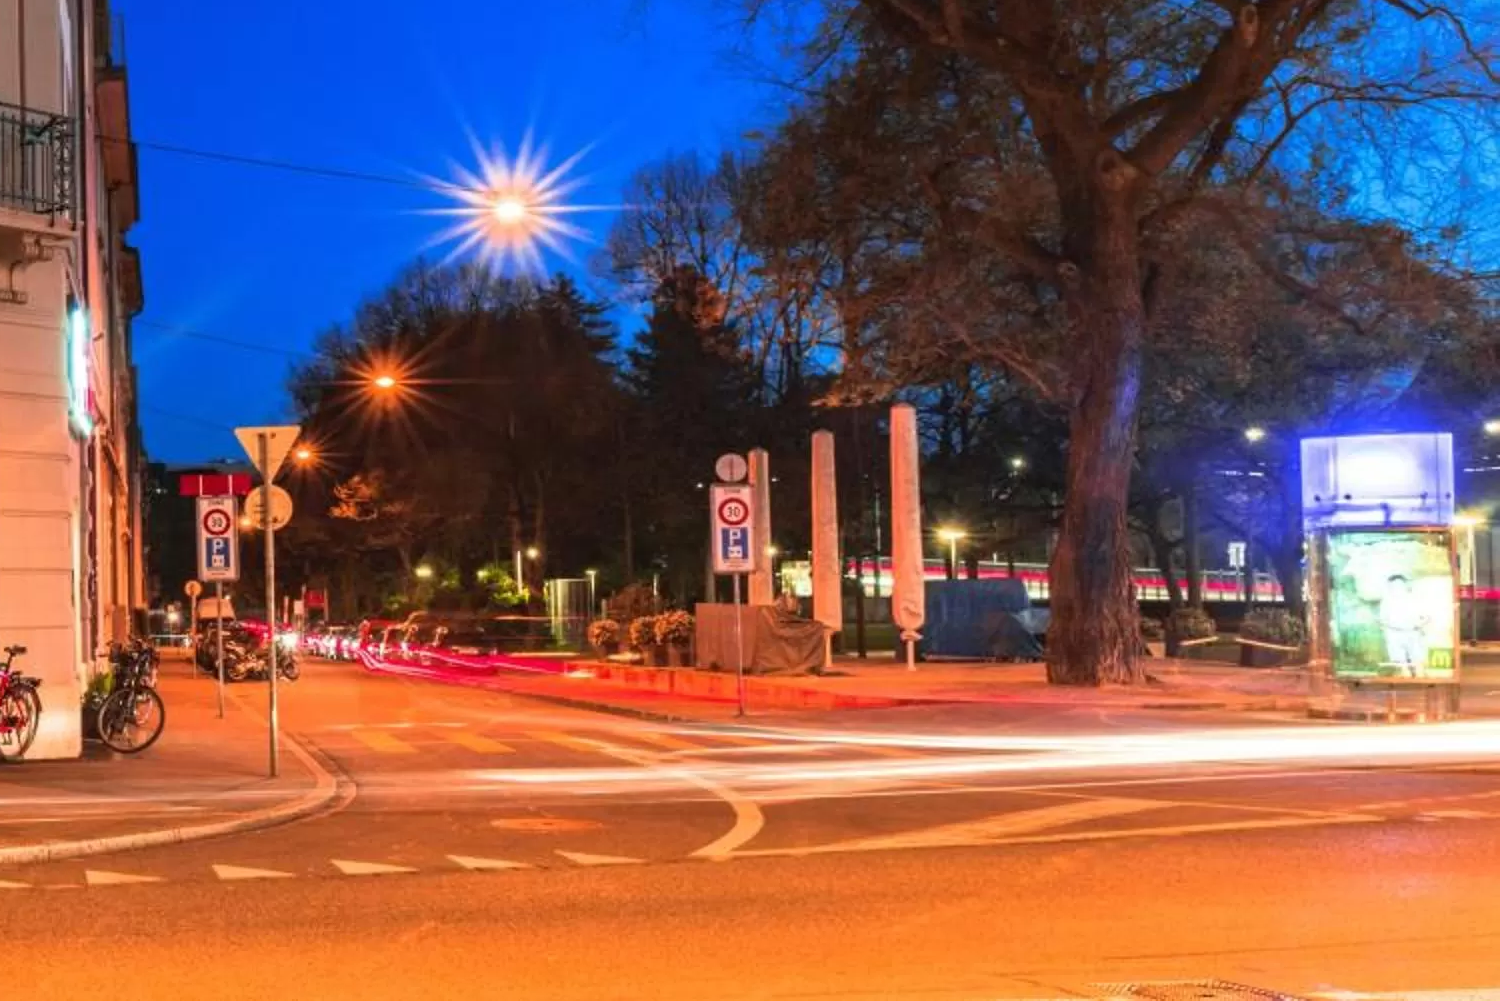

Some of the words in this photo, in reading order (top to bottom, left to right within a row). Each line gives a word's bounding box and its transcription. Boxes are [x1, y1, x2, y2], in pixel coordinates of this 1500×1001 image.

[727, 506, 740, 518] 30
[730, 528, 741, 546] P
[213, 539, 225, 555] P
